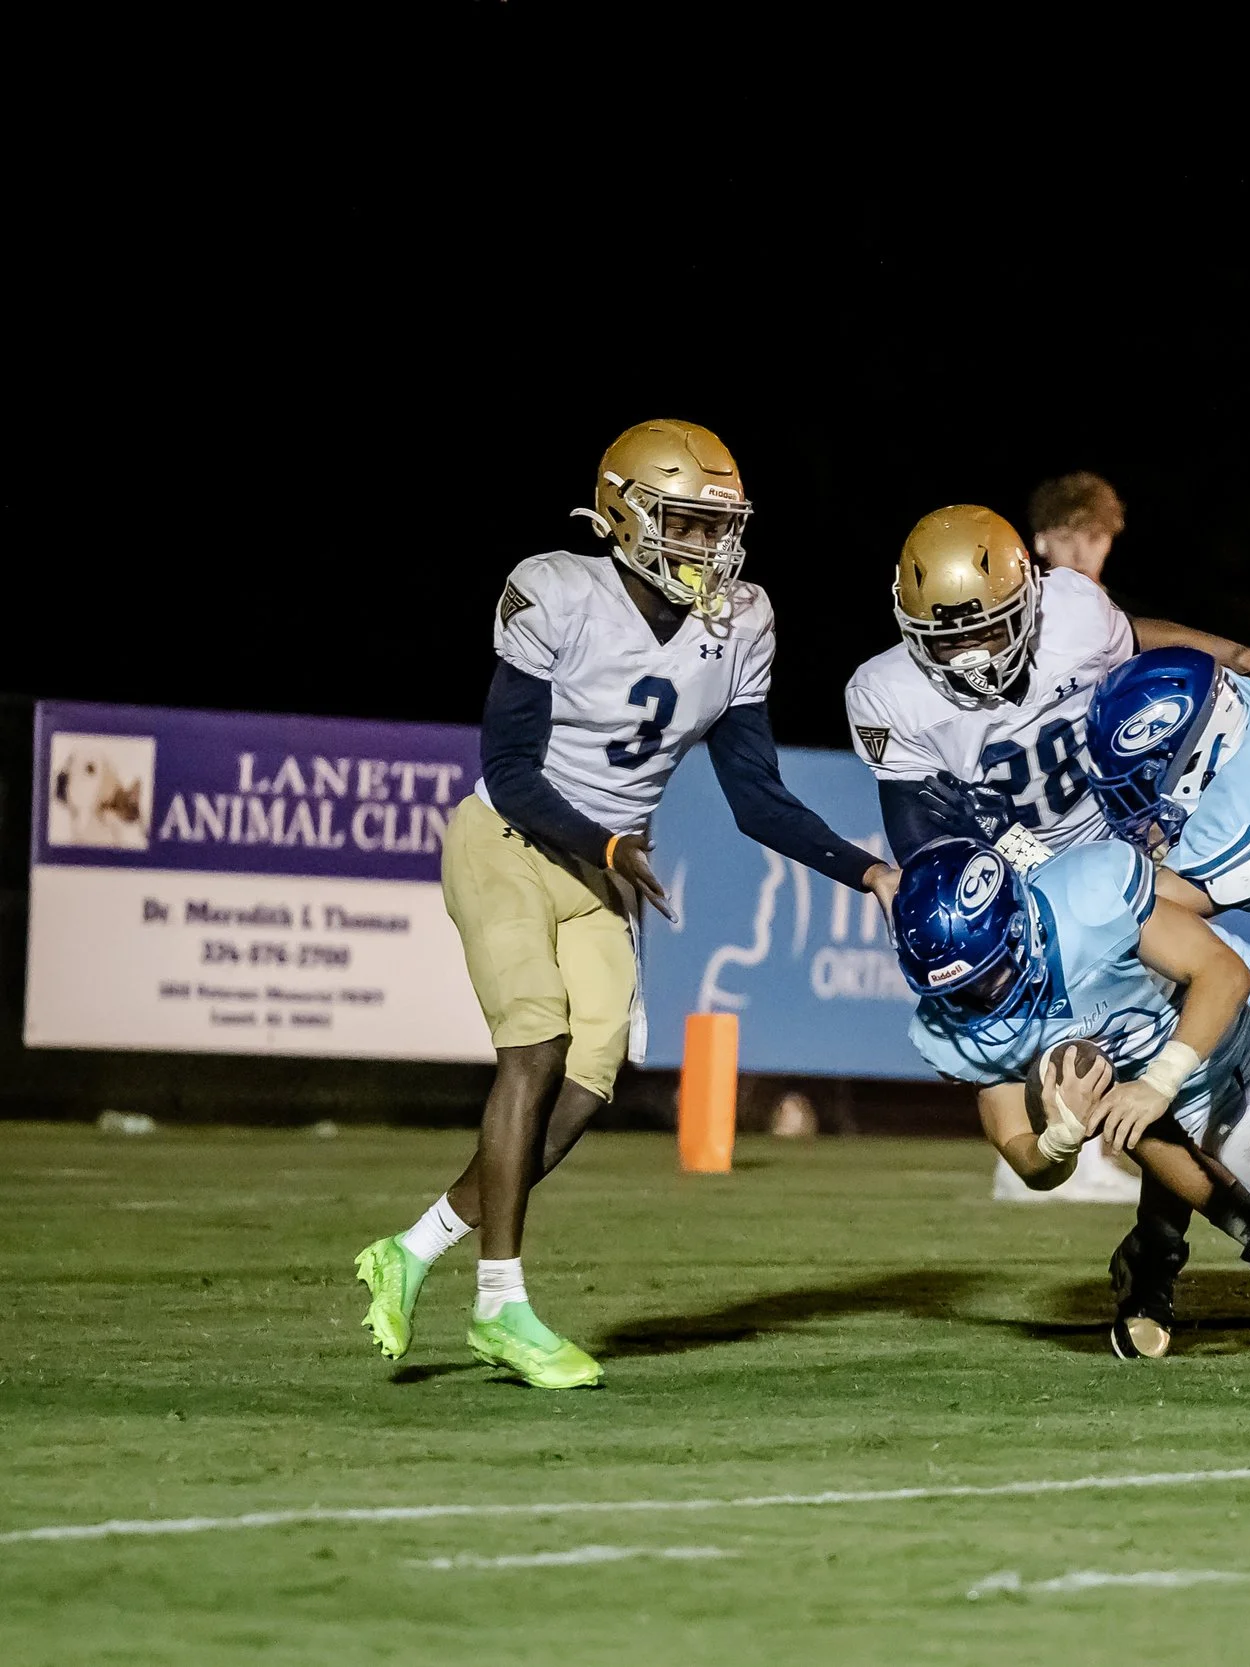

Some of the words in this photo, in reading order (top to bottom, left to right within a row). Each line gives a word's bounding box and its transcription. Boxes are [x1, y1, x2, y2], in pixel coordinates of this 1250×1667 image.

[604, 673, 679, 770] 3
[238, 752, 463, 803] LANETT
[980, 717, 1090, 827] 28
[158, 792, 346, 850] ANIMAL
[930, 964, 963, 983] Riddell
